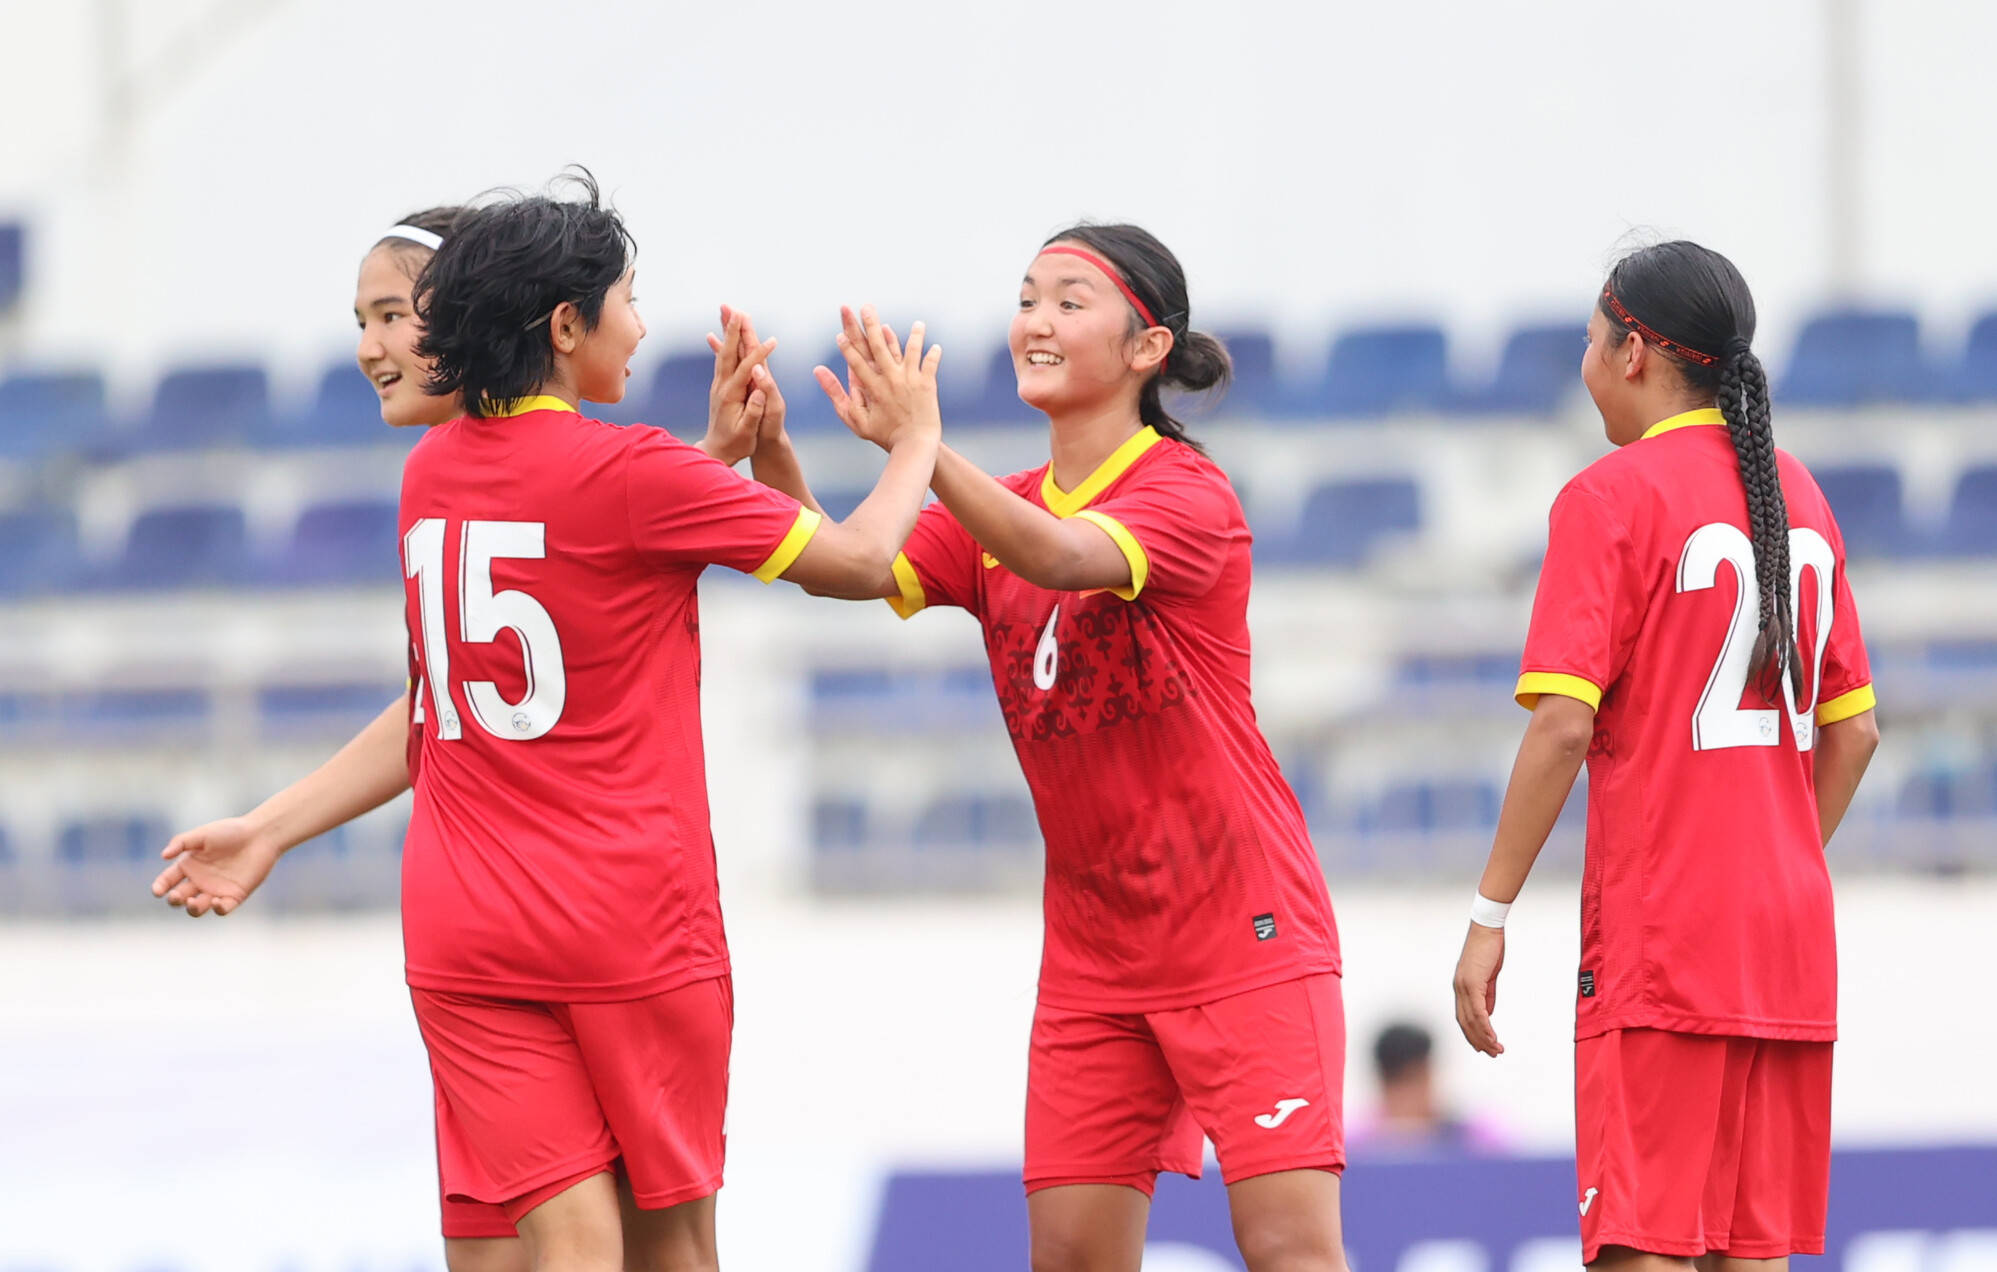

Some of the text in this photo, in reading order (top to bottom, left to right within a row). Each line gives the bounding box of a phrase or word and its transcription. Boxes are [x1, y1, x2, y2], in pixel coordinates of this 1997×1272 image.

[403, 518, 567, 741] 15
[1033, 603, 1060, 691] 6
[1675, 522, 1836, 752] 20
